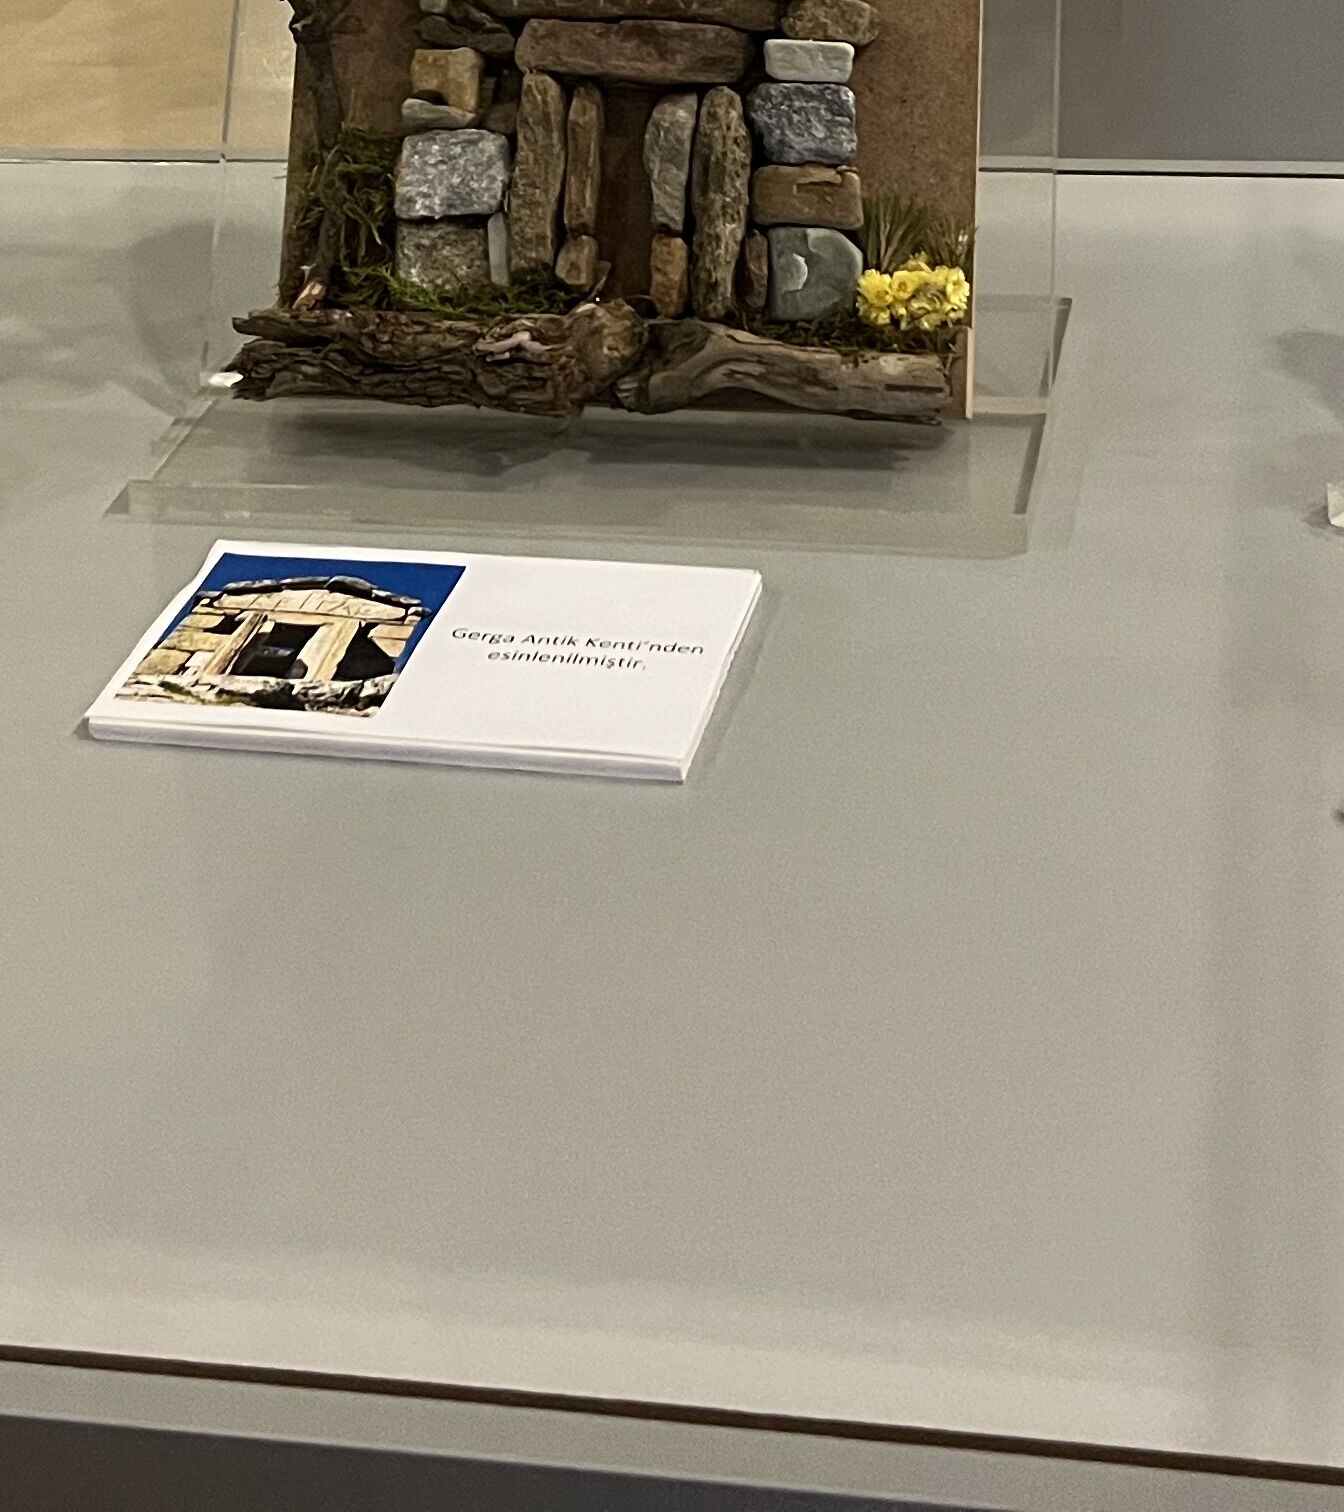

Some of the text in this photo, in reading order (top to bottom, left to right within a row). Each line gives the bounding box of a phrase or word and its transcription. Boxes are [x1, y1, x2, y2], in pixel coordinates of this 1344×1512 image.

[451, 627, 705, 656] Gerga Antik Kenti'nden
